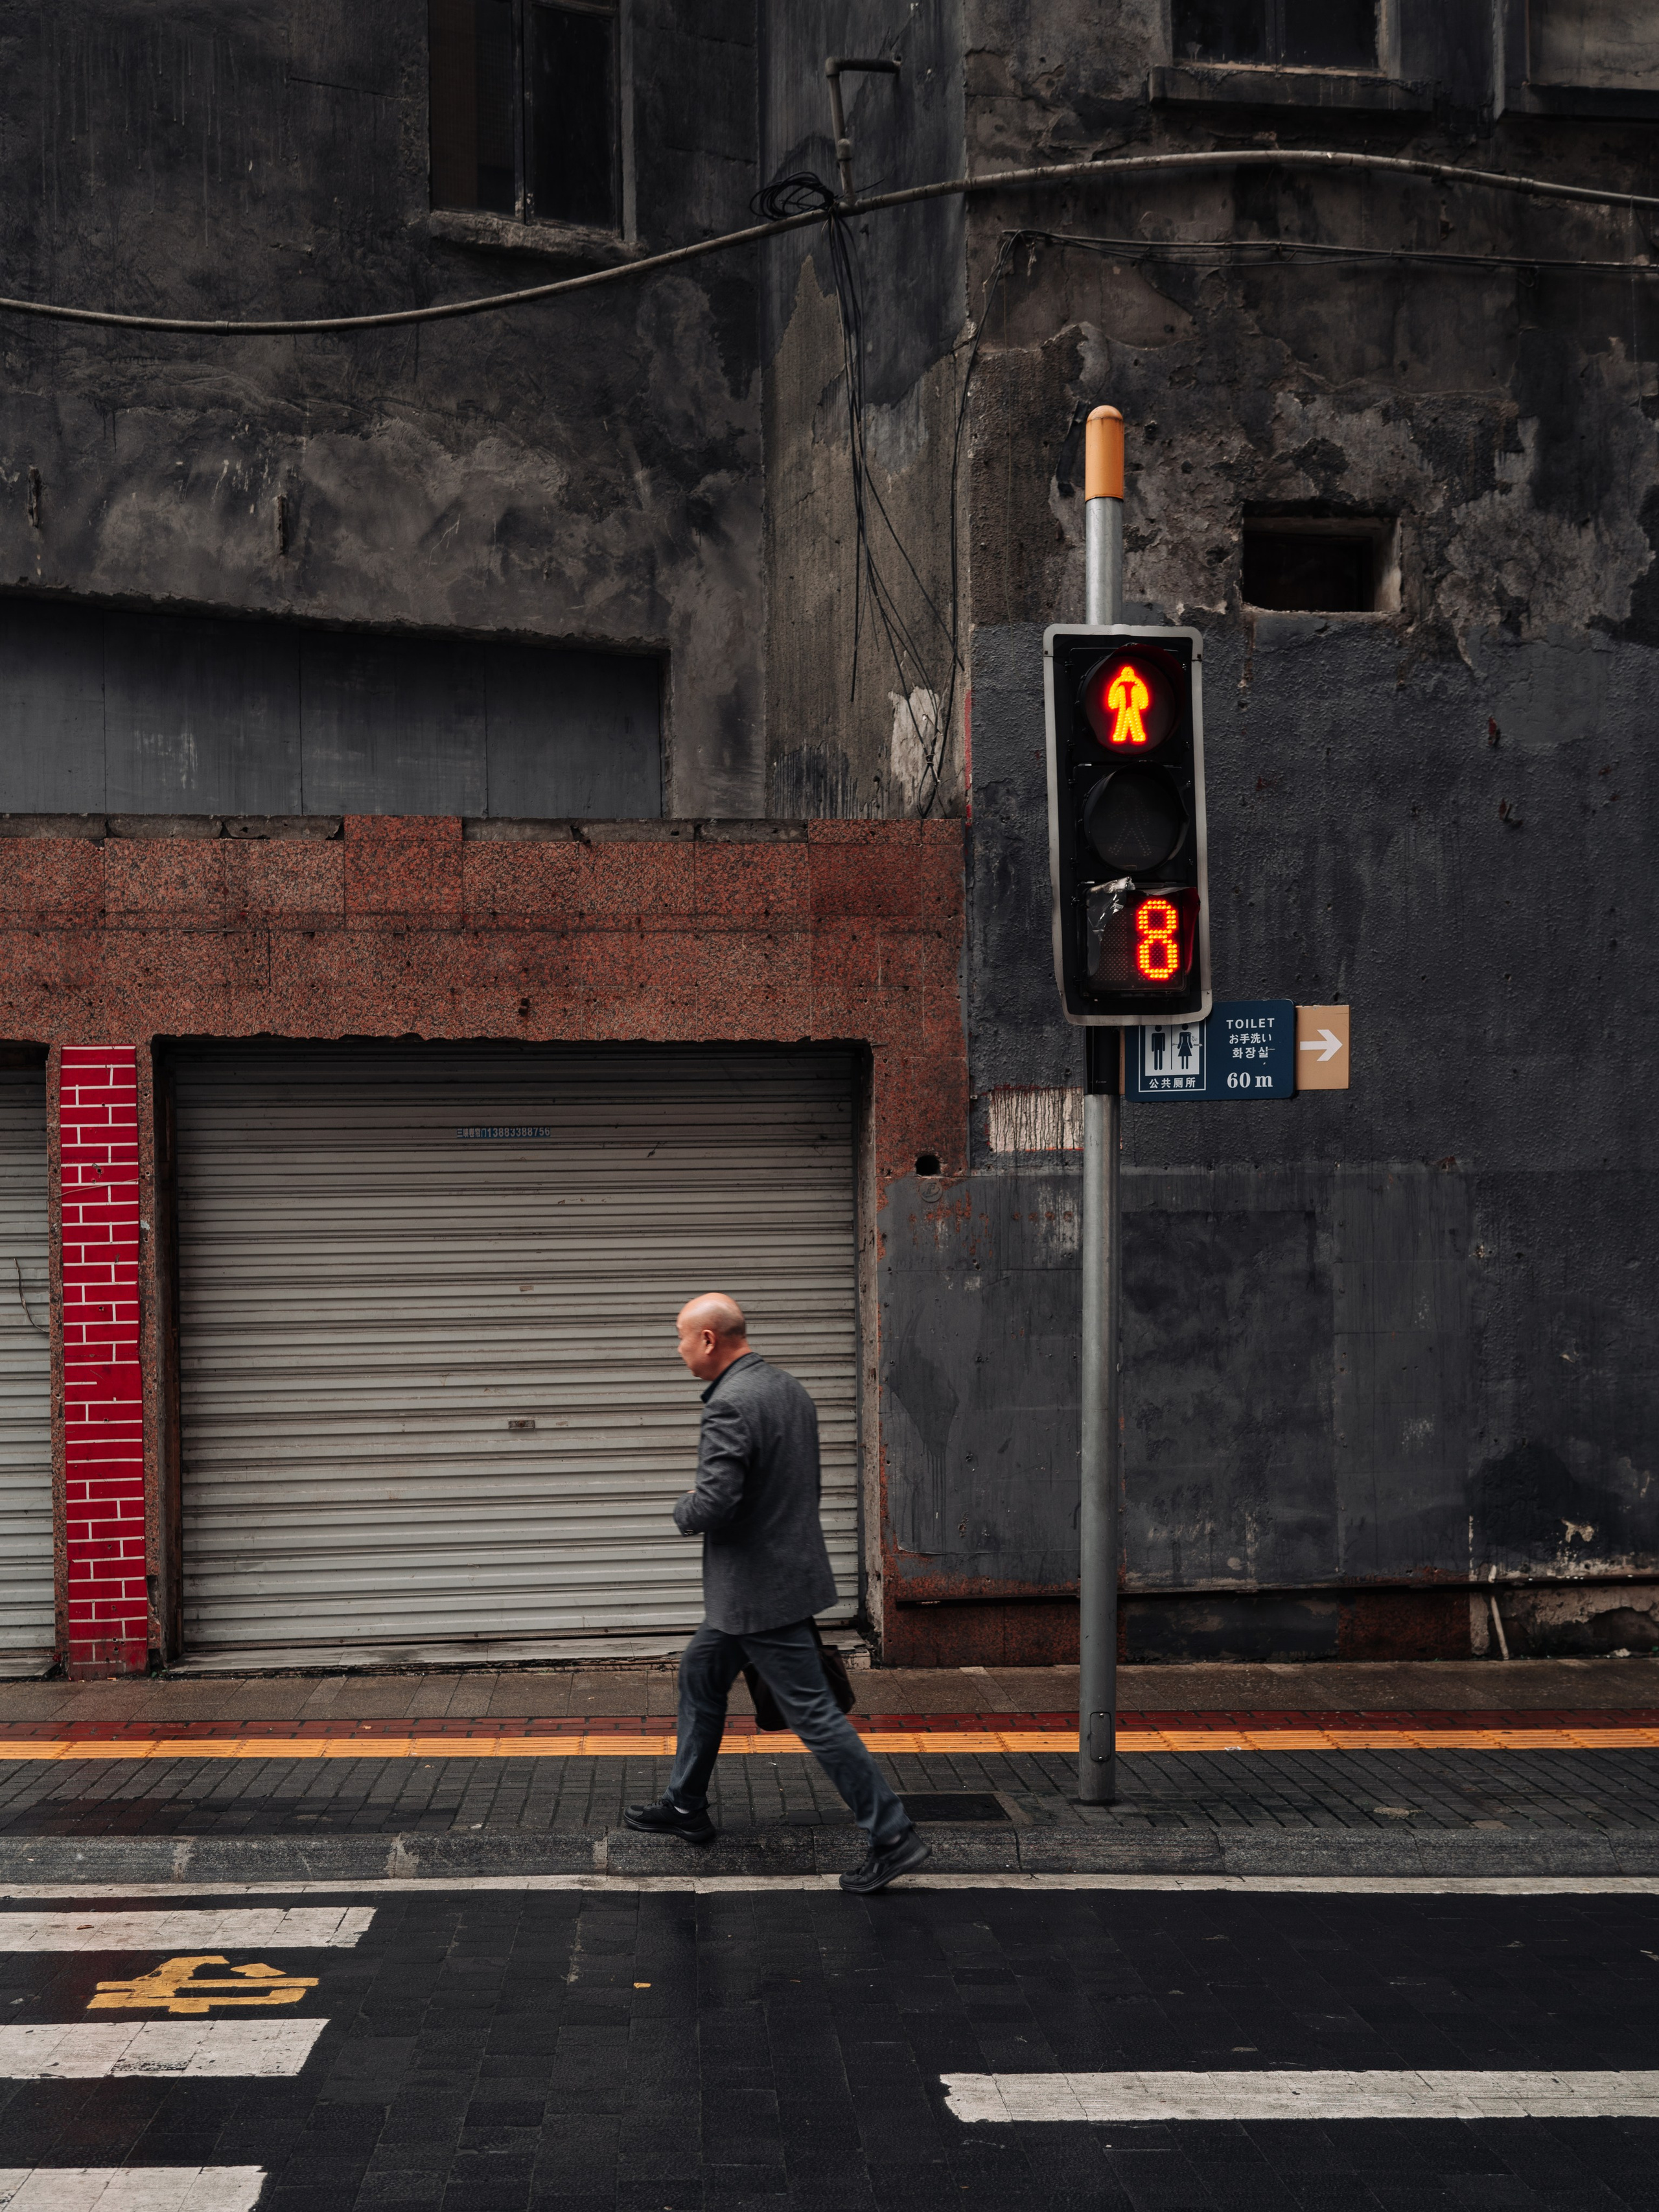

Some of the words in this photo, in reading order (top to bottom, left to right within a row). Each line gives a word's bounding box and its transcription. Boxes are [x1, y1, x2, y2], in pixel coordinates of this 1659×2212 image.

[1137, 900, 1178, 979] 8
[1226, 1018, 1275, 1029] TOILET
[1229, 1032, 1271, 1044] お手洗い
[1232, 1046, 1269, 1059] 화장실
[1149, 1077, 1196, 1089] 公共厕所
